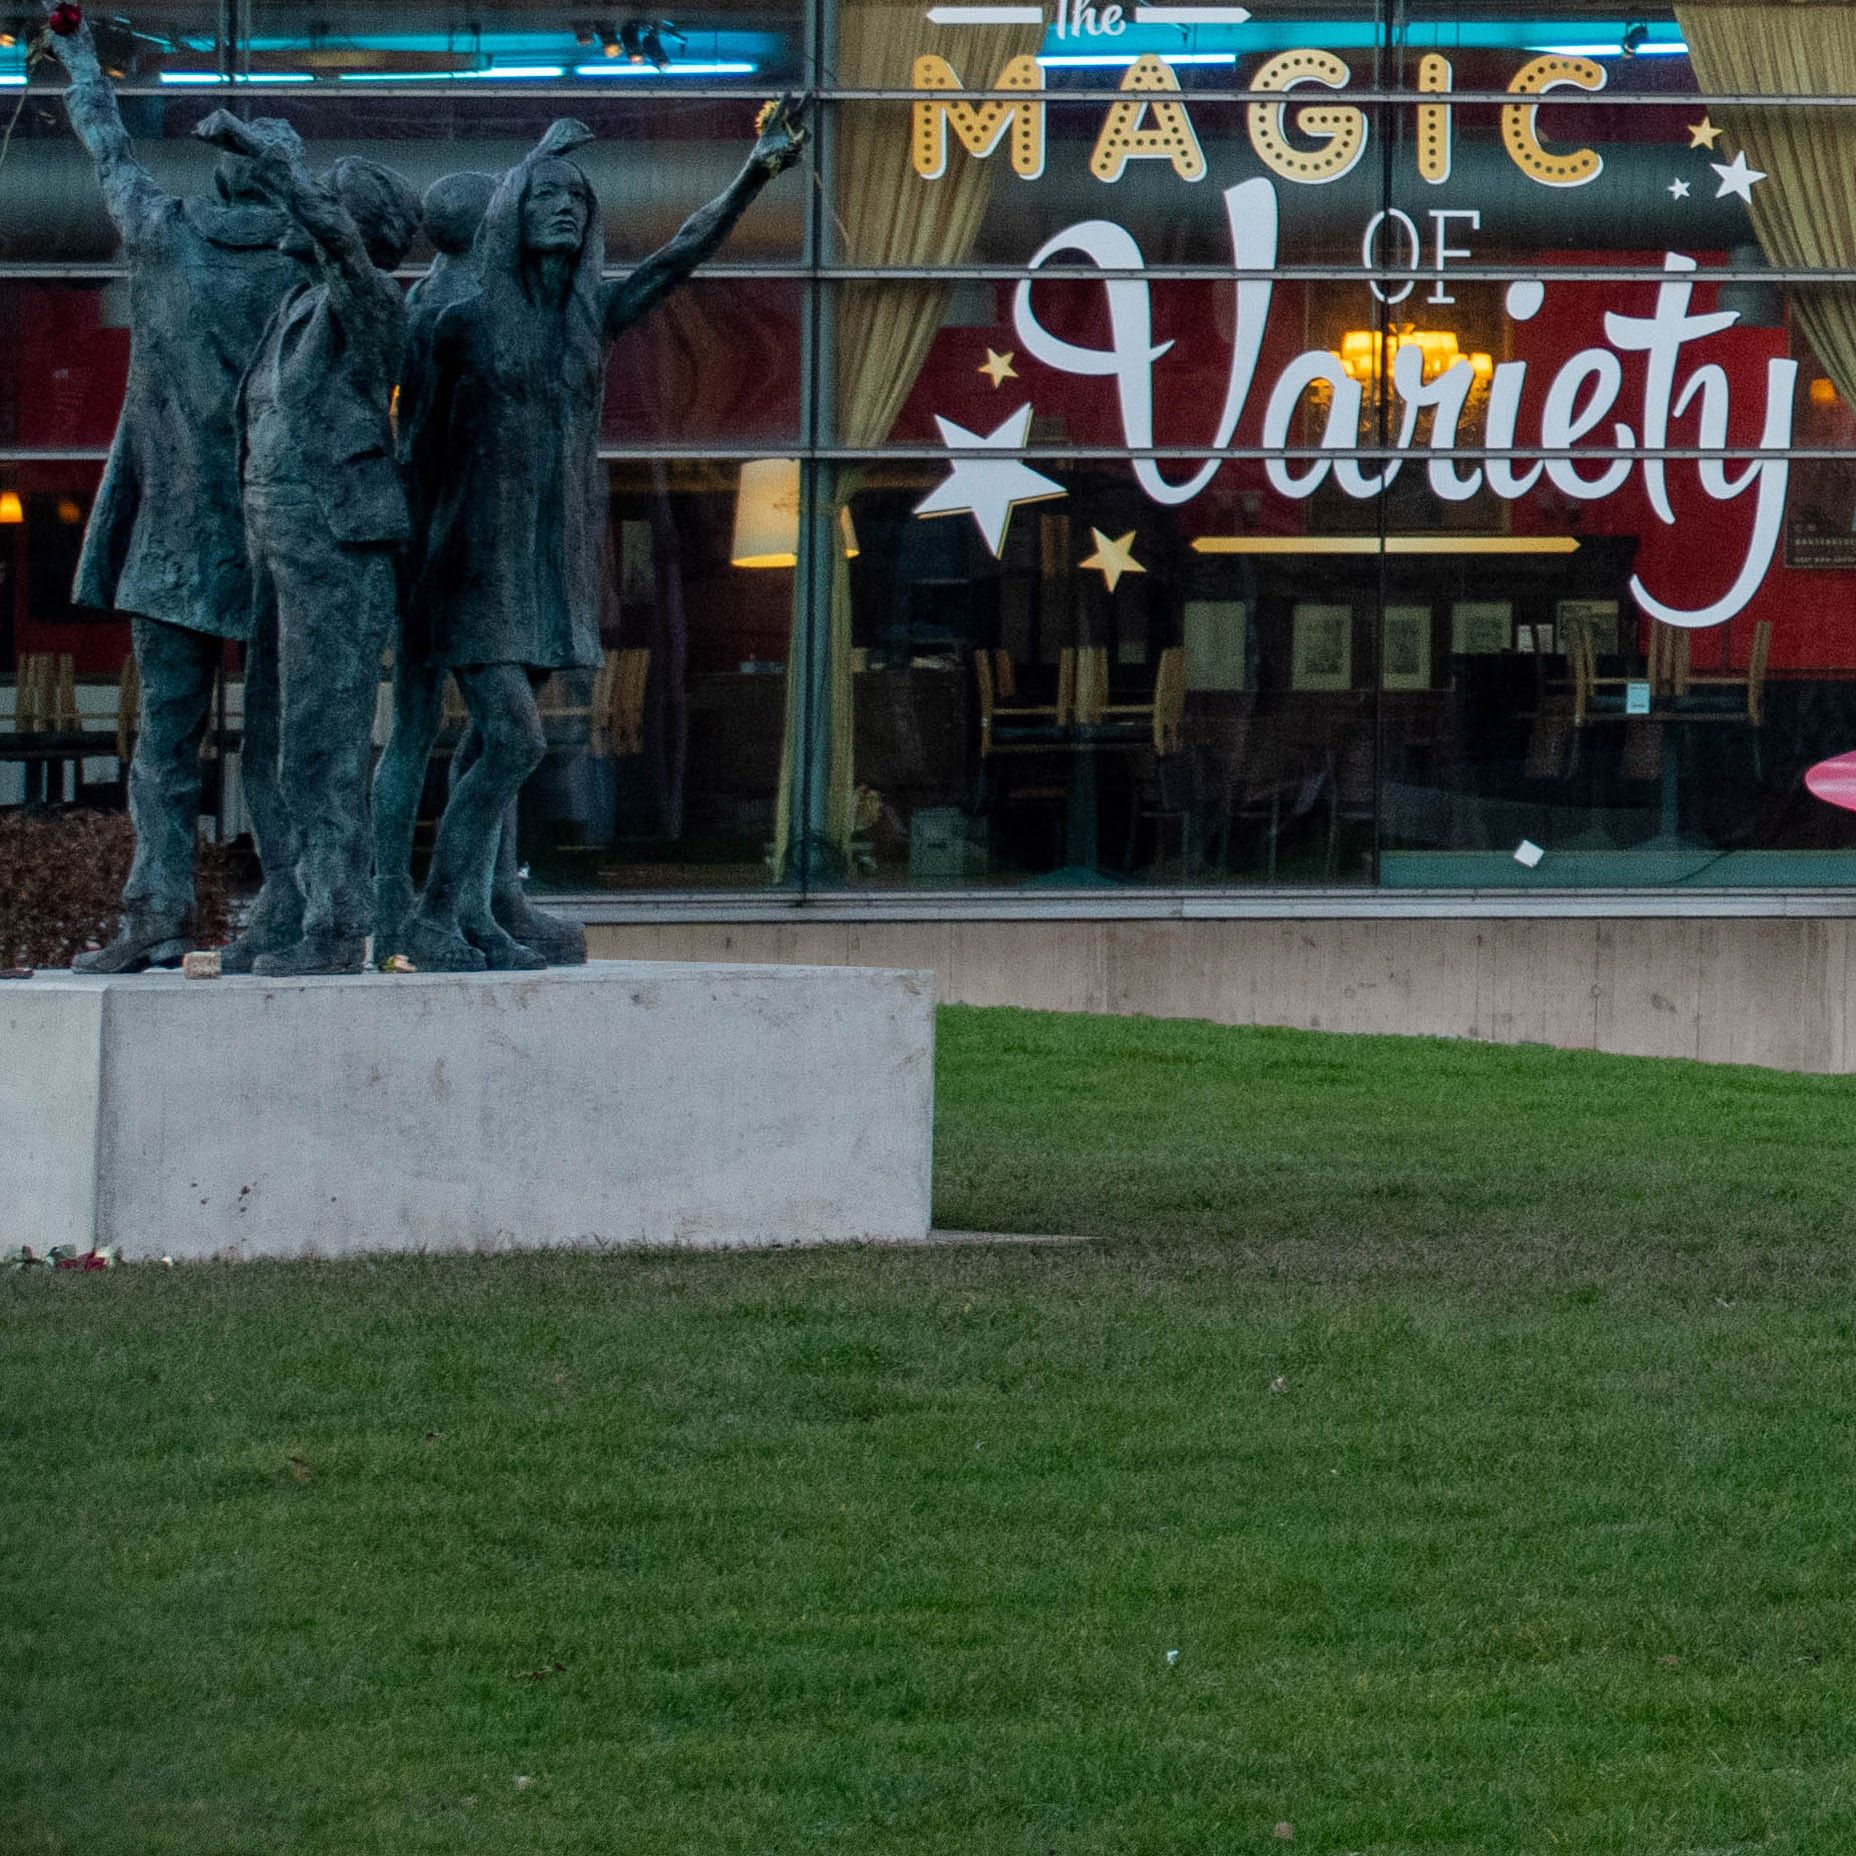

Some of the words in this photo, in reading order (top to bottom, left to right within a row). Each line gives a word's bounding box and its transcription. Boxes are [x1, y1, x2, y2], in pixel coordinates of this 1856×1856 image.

[912, 48, 1607, 186] MAGIC
[1362, 208, 1480, 305] OF
[1014, 177, 1799, 629] Variety
